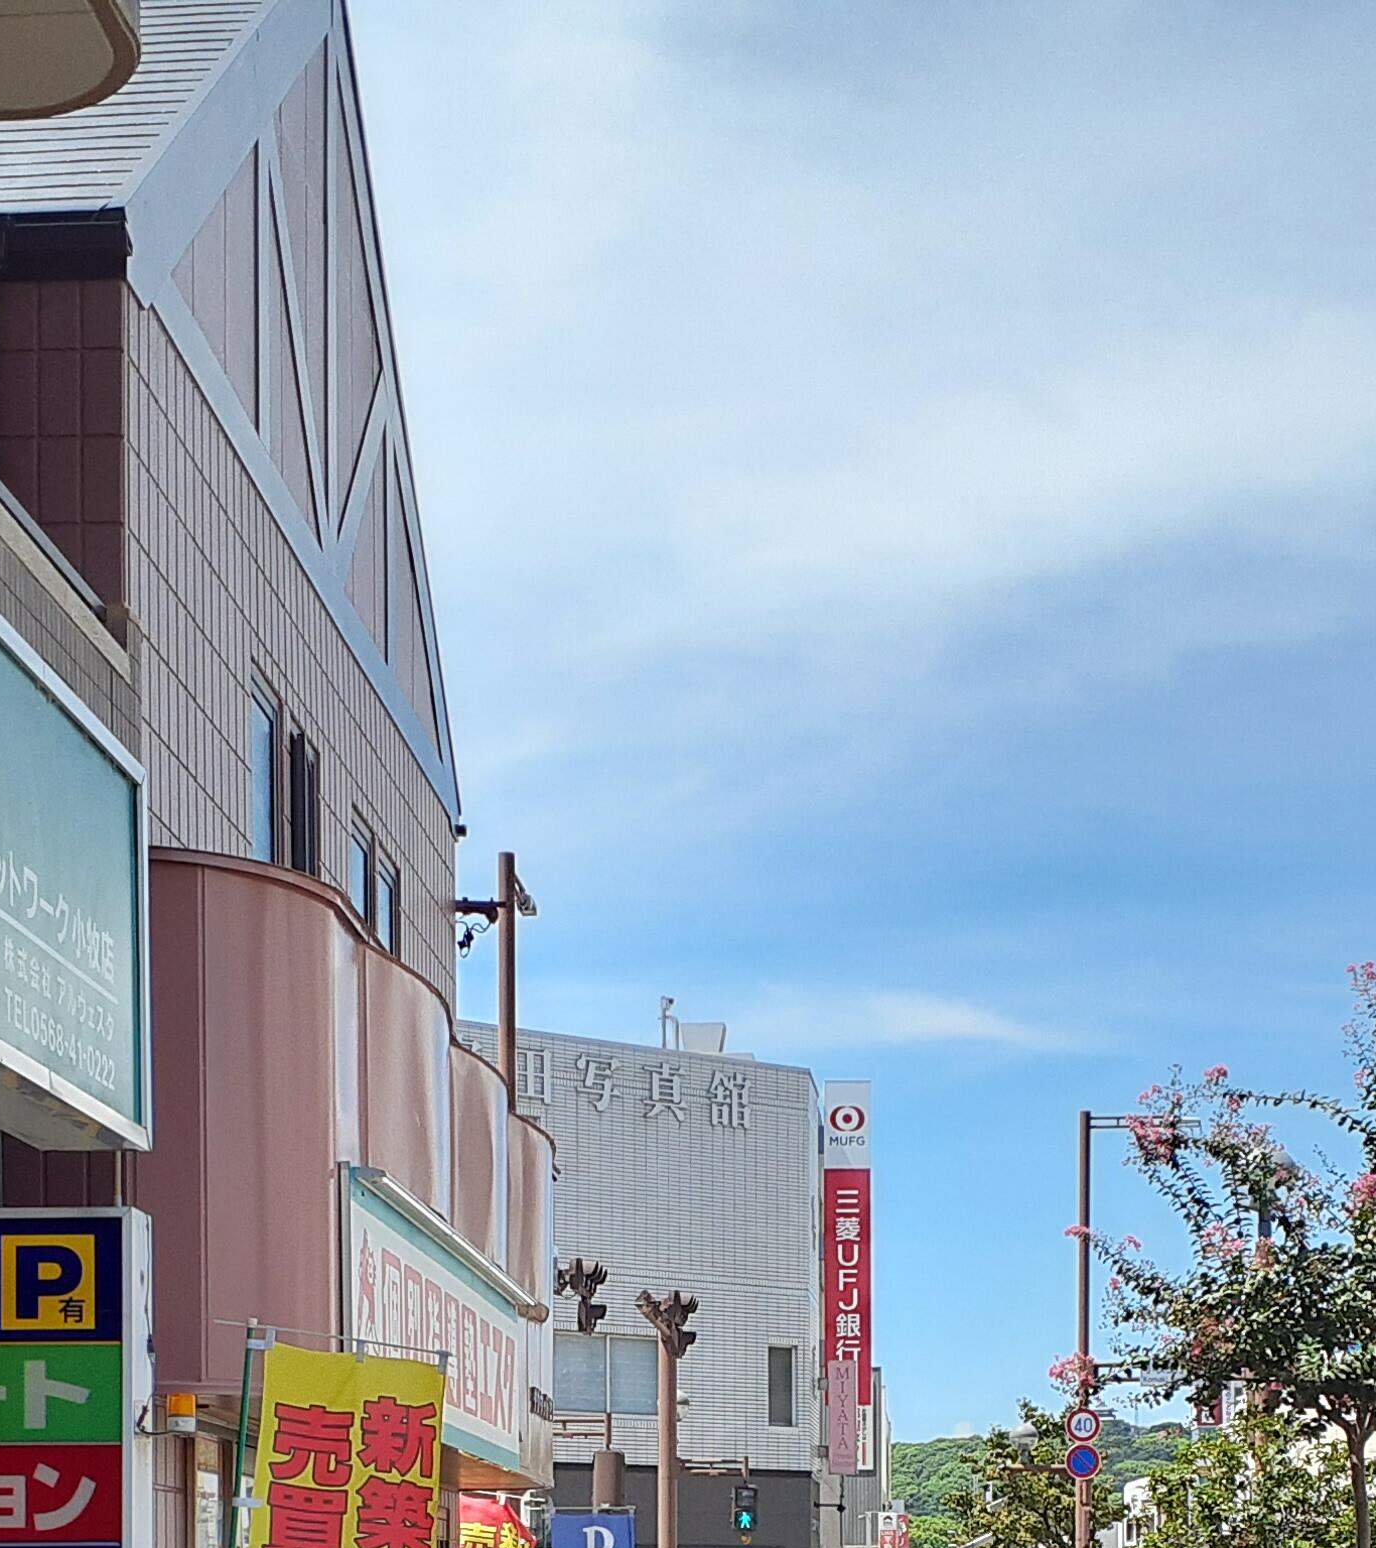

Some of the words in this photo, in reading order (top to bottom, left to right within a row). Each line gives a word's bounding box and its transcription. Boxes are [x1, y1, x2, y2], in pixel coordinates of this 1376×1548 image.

[462, 1038, 752, 1131] 田写真館
[829, 1136, 866, 1147] MUFG
[15, 1245, 83, 1319] P
[58, 1297, 86, 1324] 有
[835, 1188, 862, 1361] 三菱UFJ銀行
[835, 1366, 850, 1451] MIYATA
[1074, 1417, 1093, 1434] 40
